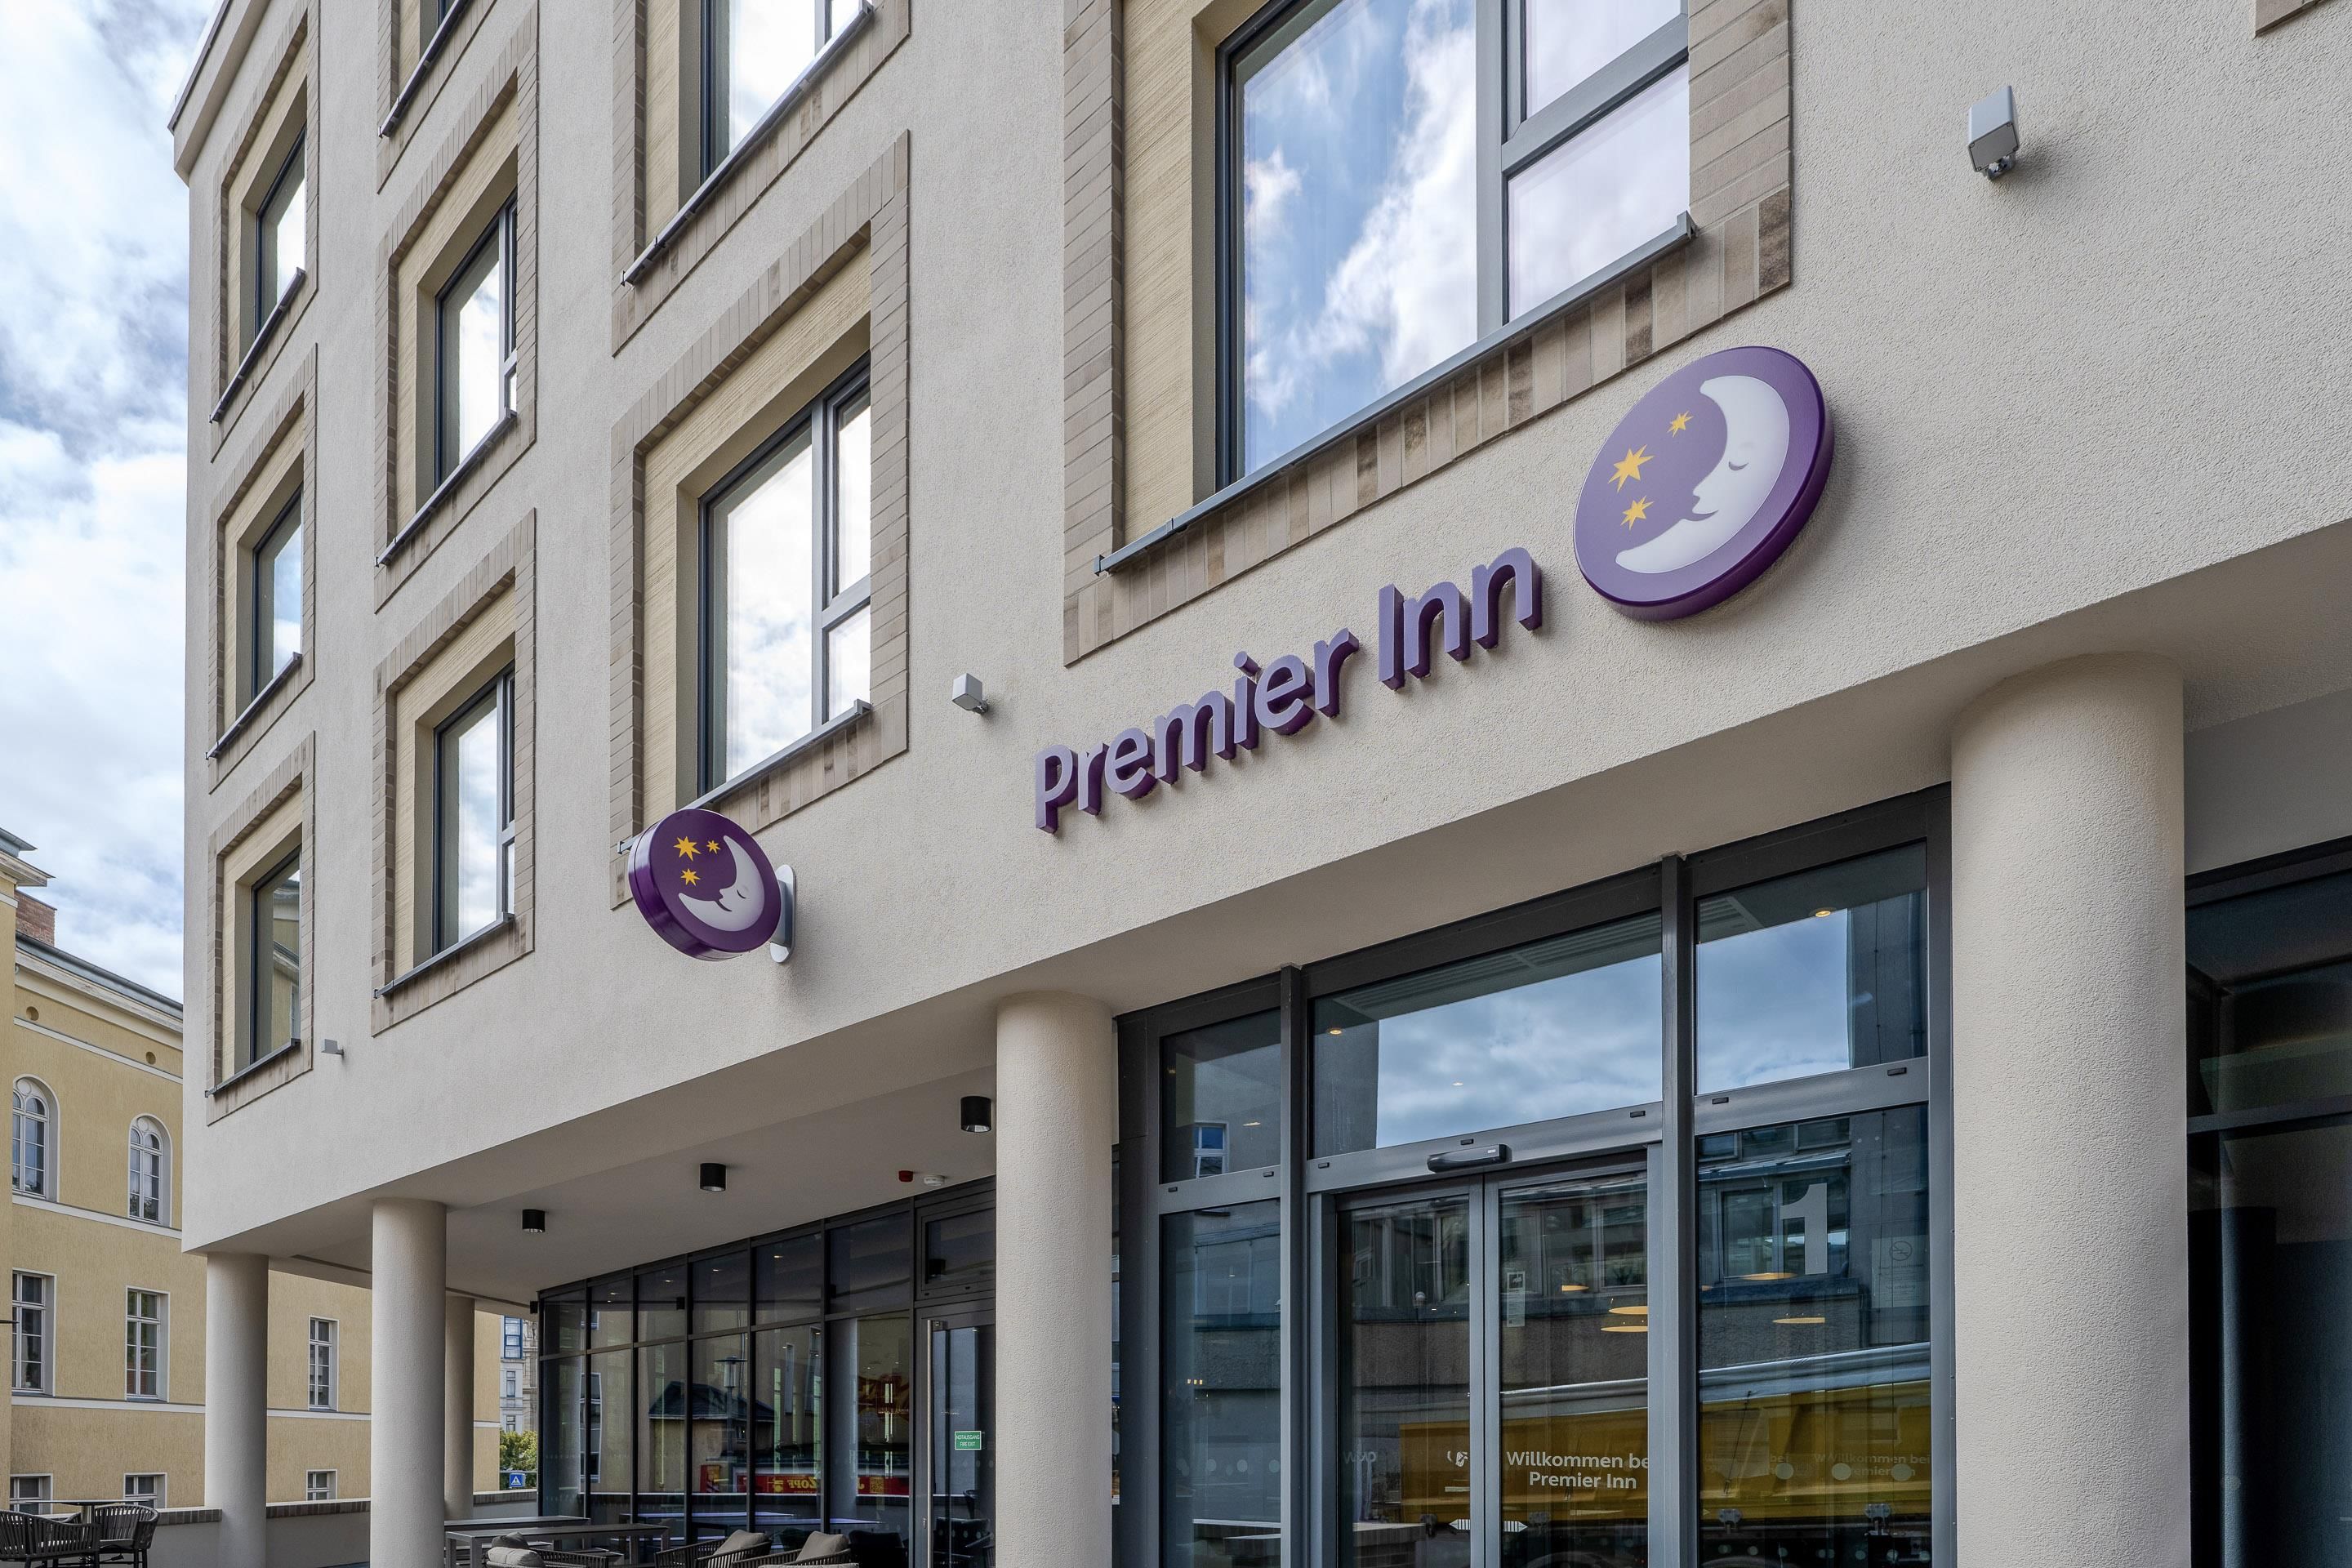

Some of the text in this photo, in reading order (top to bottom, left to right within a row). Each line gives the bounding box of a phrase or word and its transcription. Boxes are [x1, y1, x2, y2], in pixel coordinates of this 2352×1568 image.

[1036, 547, 1542, 834] Premier Inn
[1780, 1183, 1828, 1275] 1
[1506, 1451, 1624, 1468] Willkommen
[1529, 1471, 1637, 1489] Premier Inn
